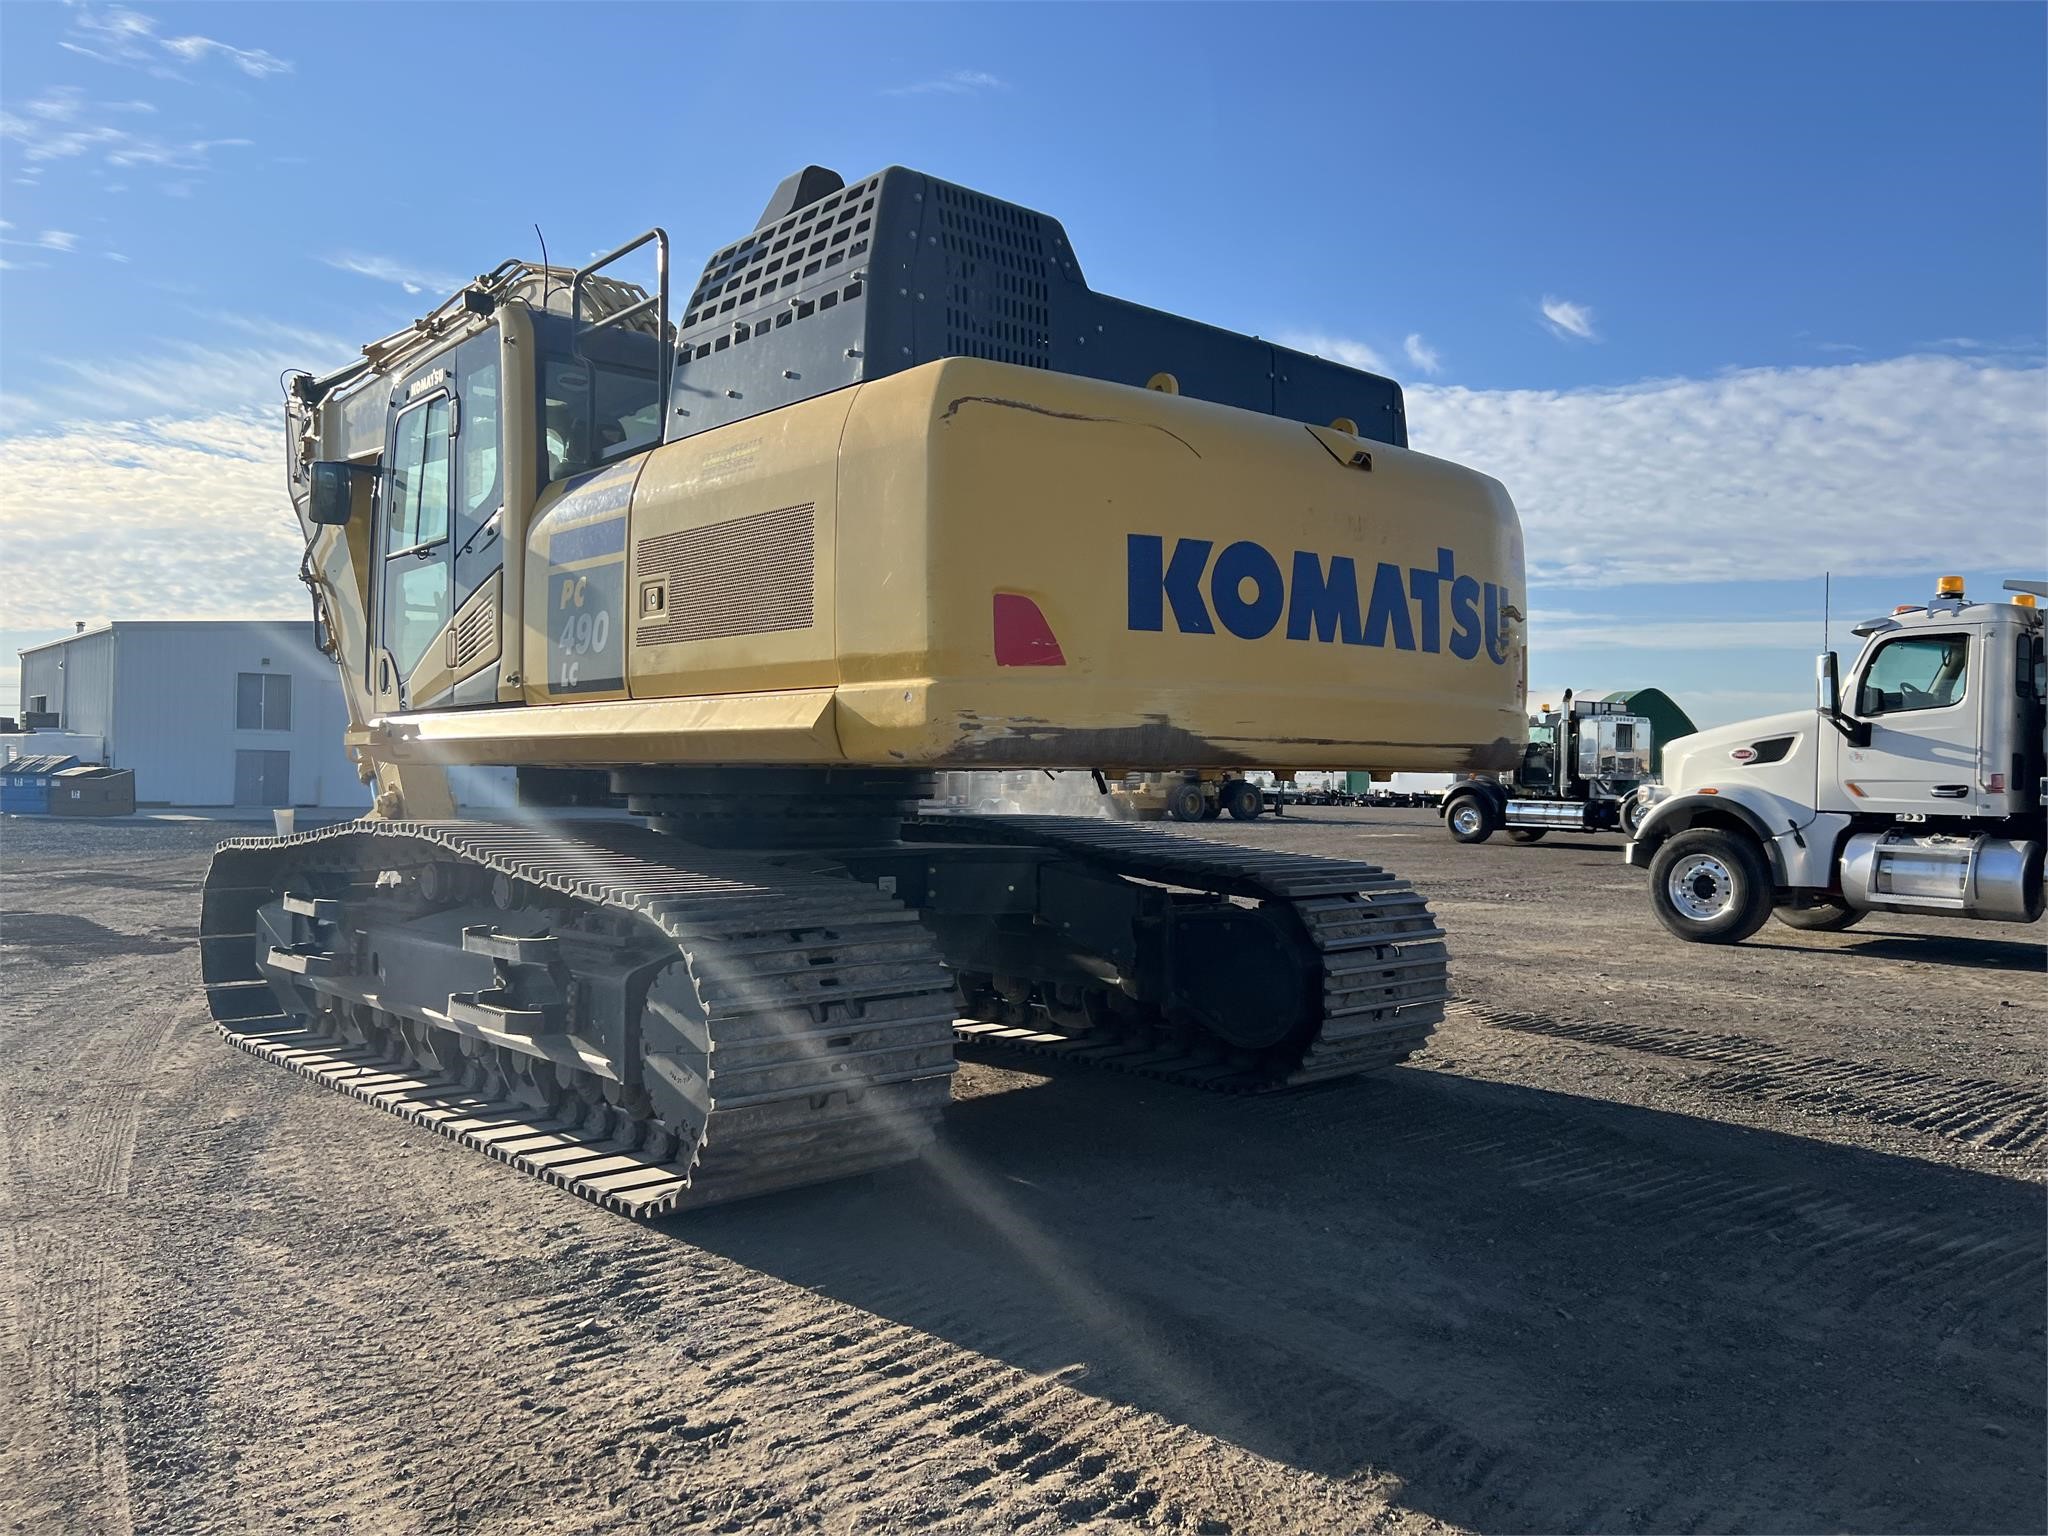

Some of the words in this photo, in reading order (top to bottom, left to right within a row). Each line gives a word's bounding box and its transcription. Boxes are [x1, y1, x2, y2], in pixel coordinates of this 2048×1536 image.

[410, 368, 444, 397] KOMATSU
[560, 576, 587, 610] PC
[1127, 533, 1509, 665] KOMATSU
[559, 610, 610, 655] 490
[560, 661, 579, 687] LC
